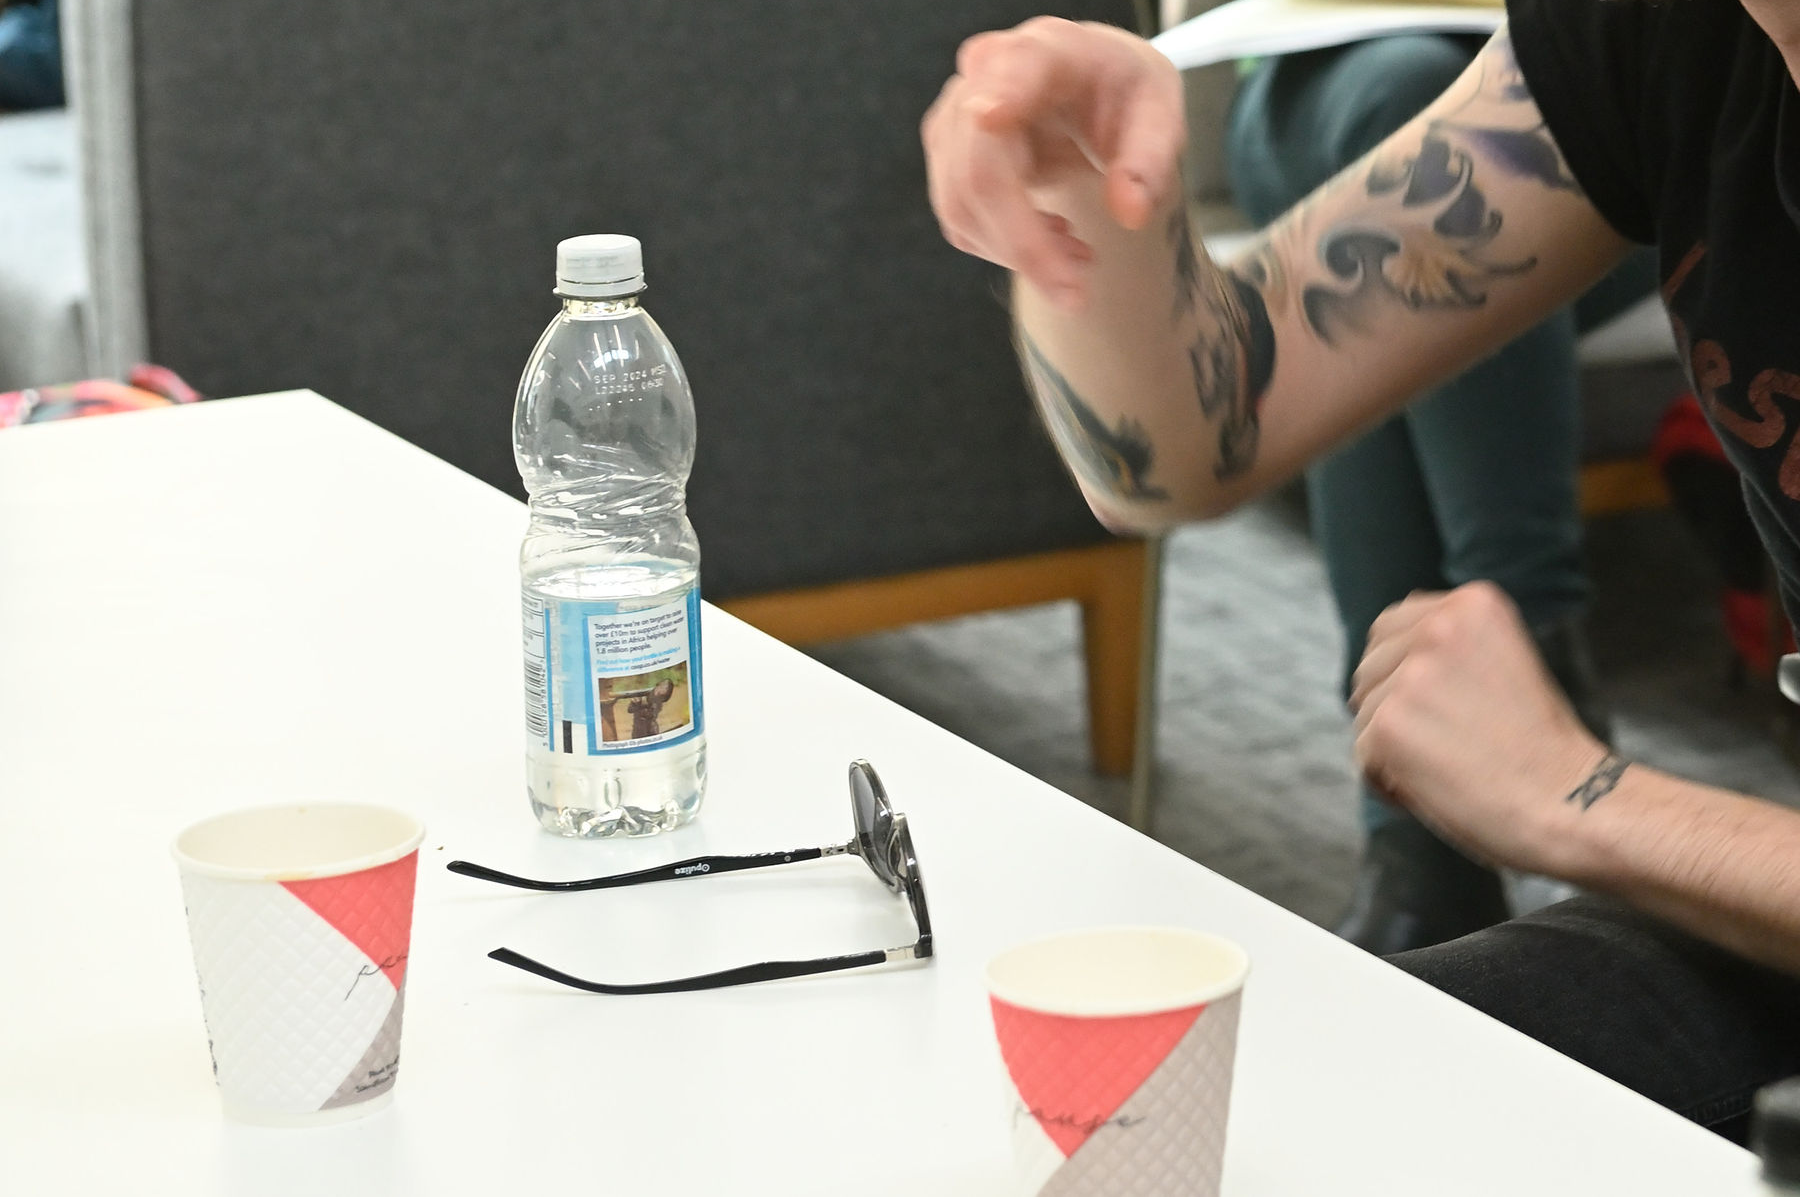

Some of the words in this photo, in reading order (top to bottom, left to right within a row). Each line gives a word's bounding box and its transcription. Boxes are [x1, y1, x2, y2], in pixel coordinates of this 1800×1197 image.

[594, 375, 616, 384] SEP
[623, 370, 647, 381] 2024
[594, 622, 623, 631] Together
[649, 614, 666, 623] target
[595, 639, 621, 648] projects
[628, 635, 646, 644] Africa
[646, 631, 667, 641] helping
[667, 627, 678, 635] over
[610, 630, 629, 638] £10m
[637, 625, 659, 635] support
[607, 645, 629, 653] million
[674, 863, 710, 874] Opulize
